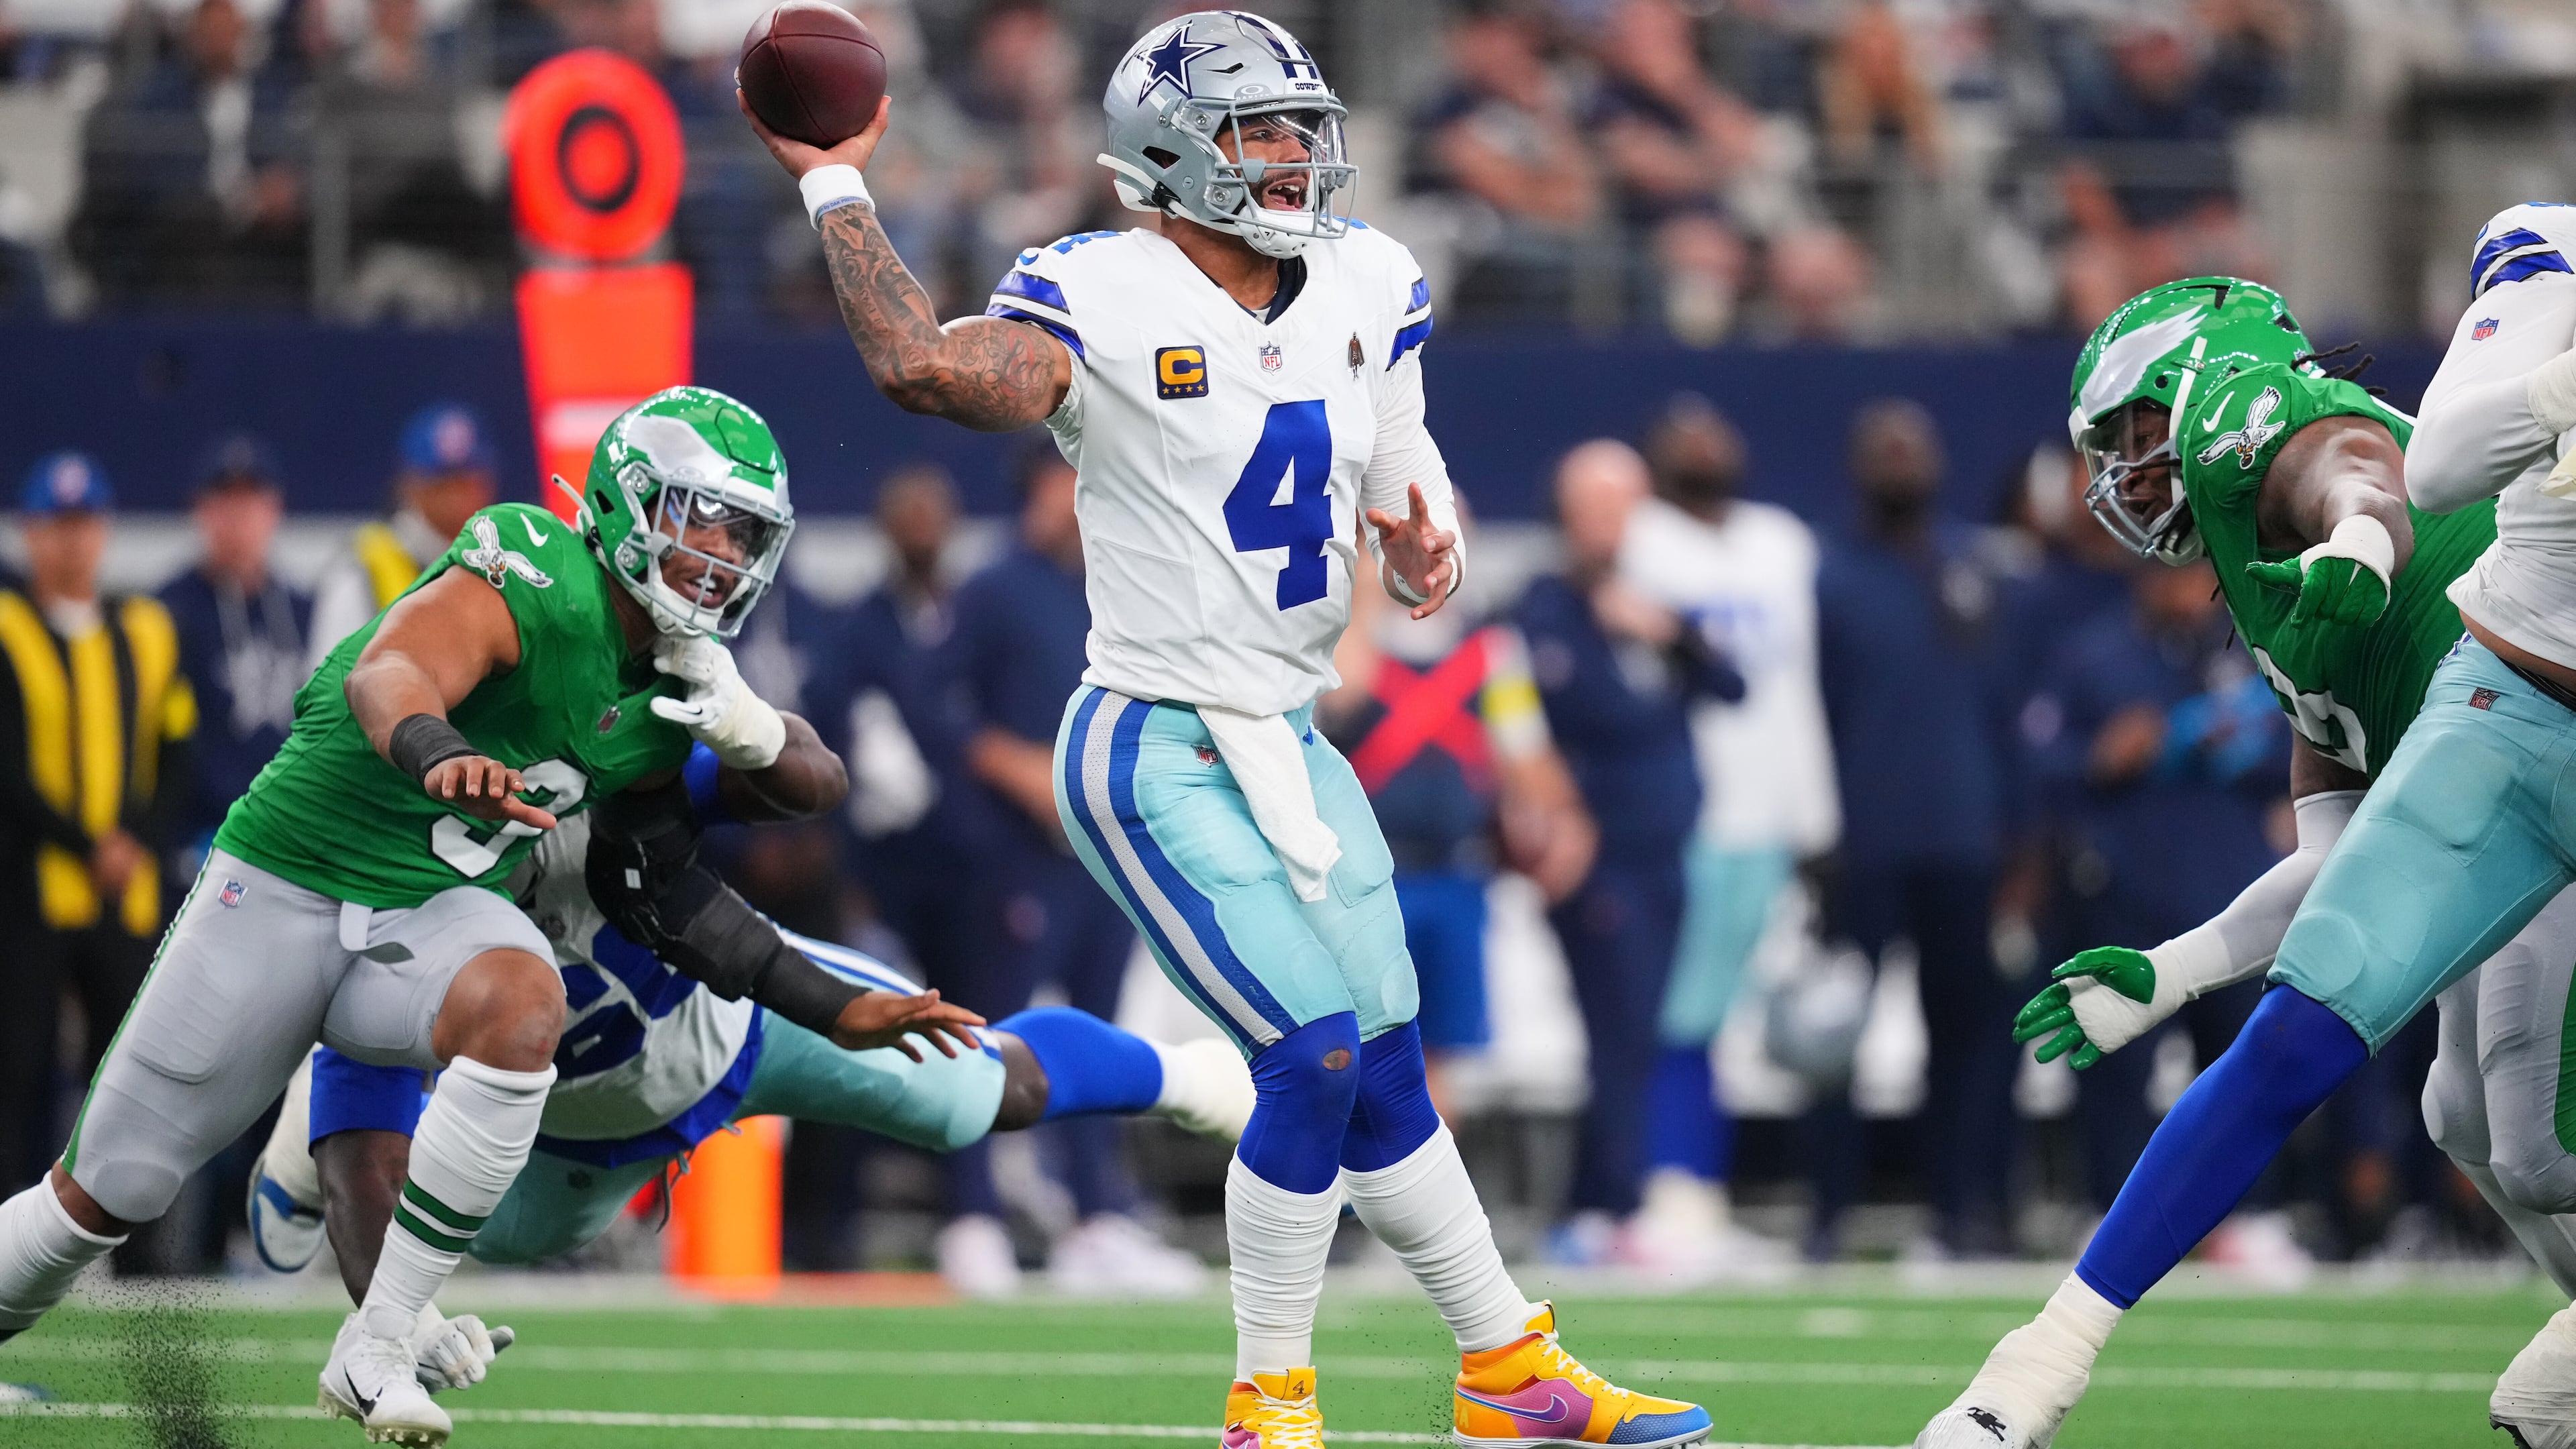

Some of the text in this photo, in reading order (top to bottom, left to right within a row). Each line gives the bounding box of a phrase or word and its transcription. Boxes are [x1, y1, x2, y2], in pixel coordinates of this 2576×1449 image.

[2473, 327, 2493, 339] NFL
[1160, 349, 1203, 385] C
[1264, 356, 1281, 369] NFL
[1222, 399, 1334, 611] 4
[1199, 751, 1217, 762] NFL
[1292, 1380, 1304, 1394] 4
